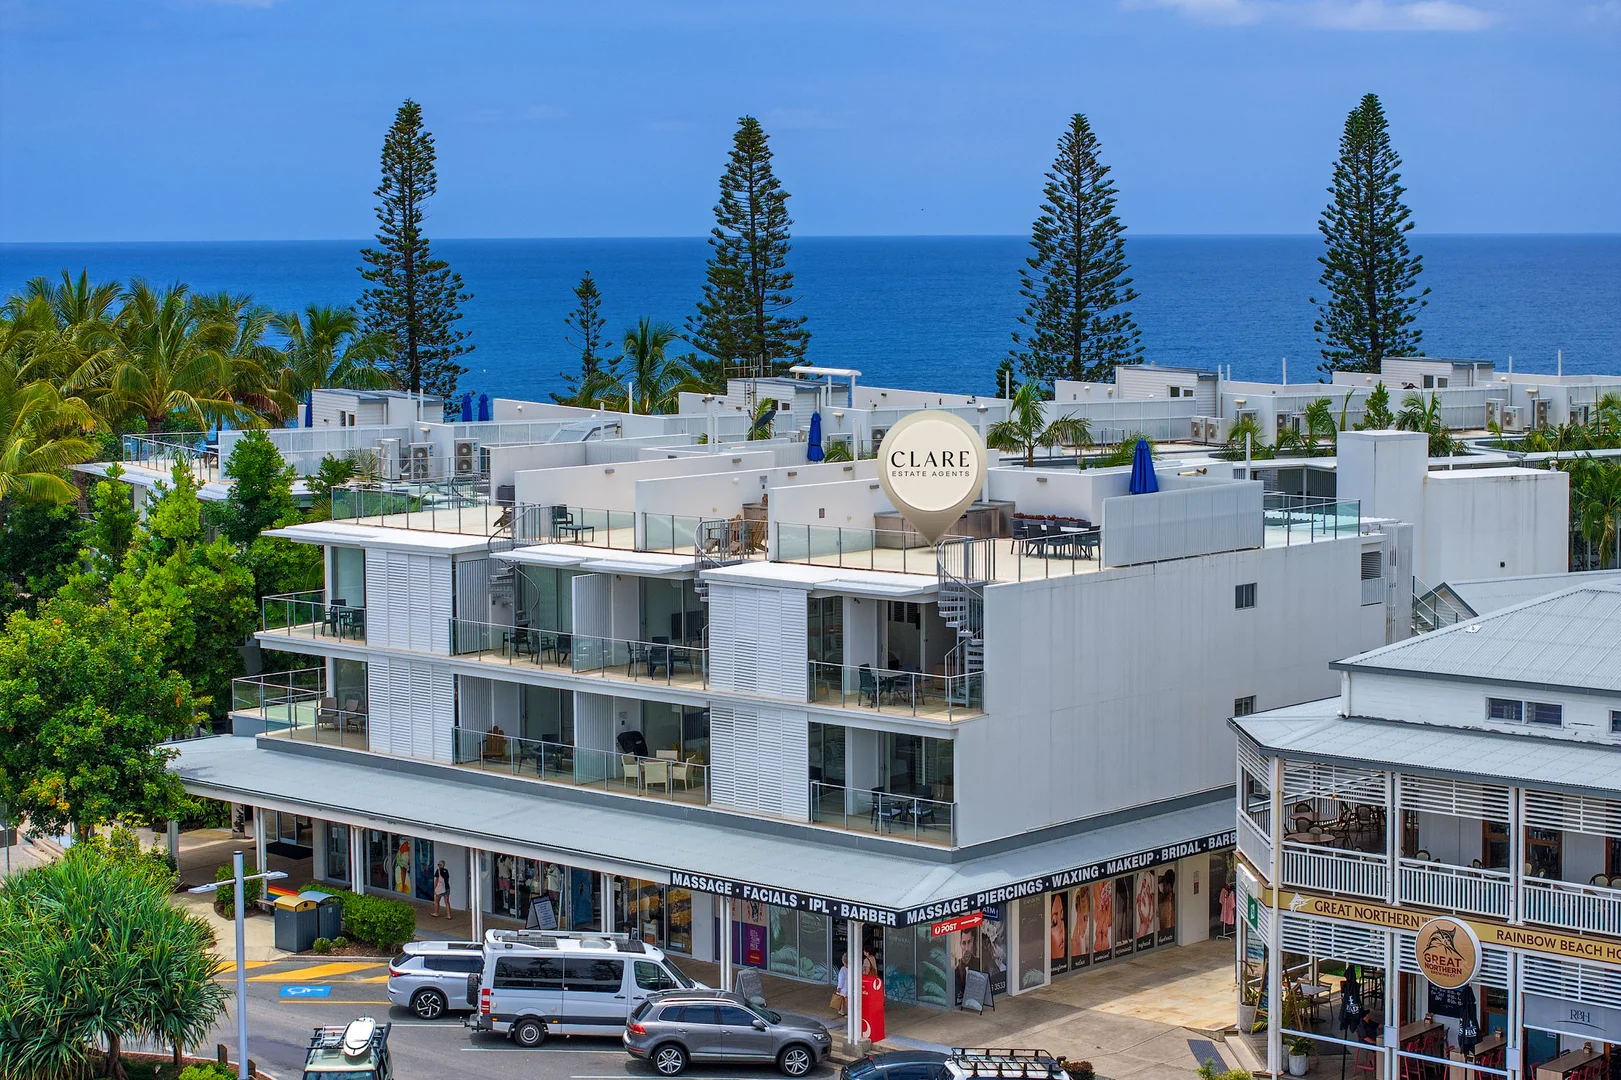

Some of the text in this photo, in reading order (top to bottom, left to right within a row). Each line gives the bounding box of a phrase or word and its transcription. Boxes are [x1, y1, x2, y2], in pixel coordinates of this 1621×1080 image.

[906, 898, 968, 925] MASSAGE
[977, 879, 1043, 907] PIERCINGS
[1052, 865, 1099, 888] WAXING
[1106, 852, 1153, 875] MAKEUP
[1161, 841, 1201, 861] BRIDAL
[672, 873, 732, 896] MASSAGE
[743, 886, 798, 908] FACIALS
[808, 898, 830, 914] IPL
[841, 903, 897, 926] BARBER
[982, 906, 996, 915] ATM
[1314, 900, 1420, 928] GREAT NORTHERN
[941, 922, 958, 934] POST
[1496, 930, 1557, 949] RAINBOW
[1560, 940, 1602, 956] BEACH
[1424, 953, 1462, 967] GREAT
[1424, 962, 1462, 975] NORTHERN
[1570, 1009, 1591, 1023] RBH
